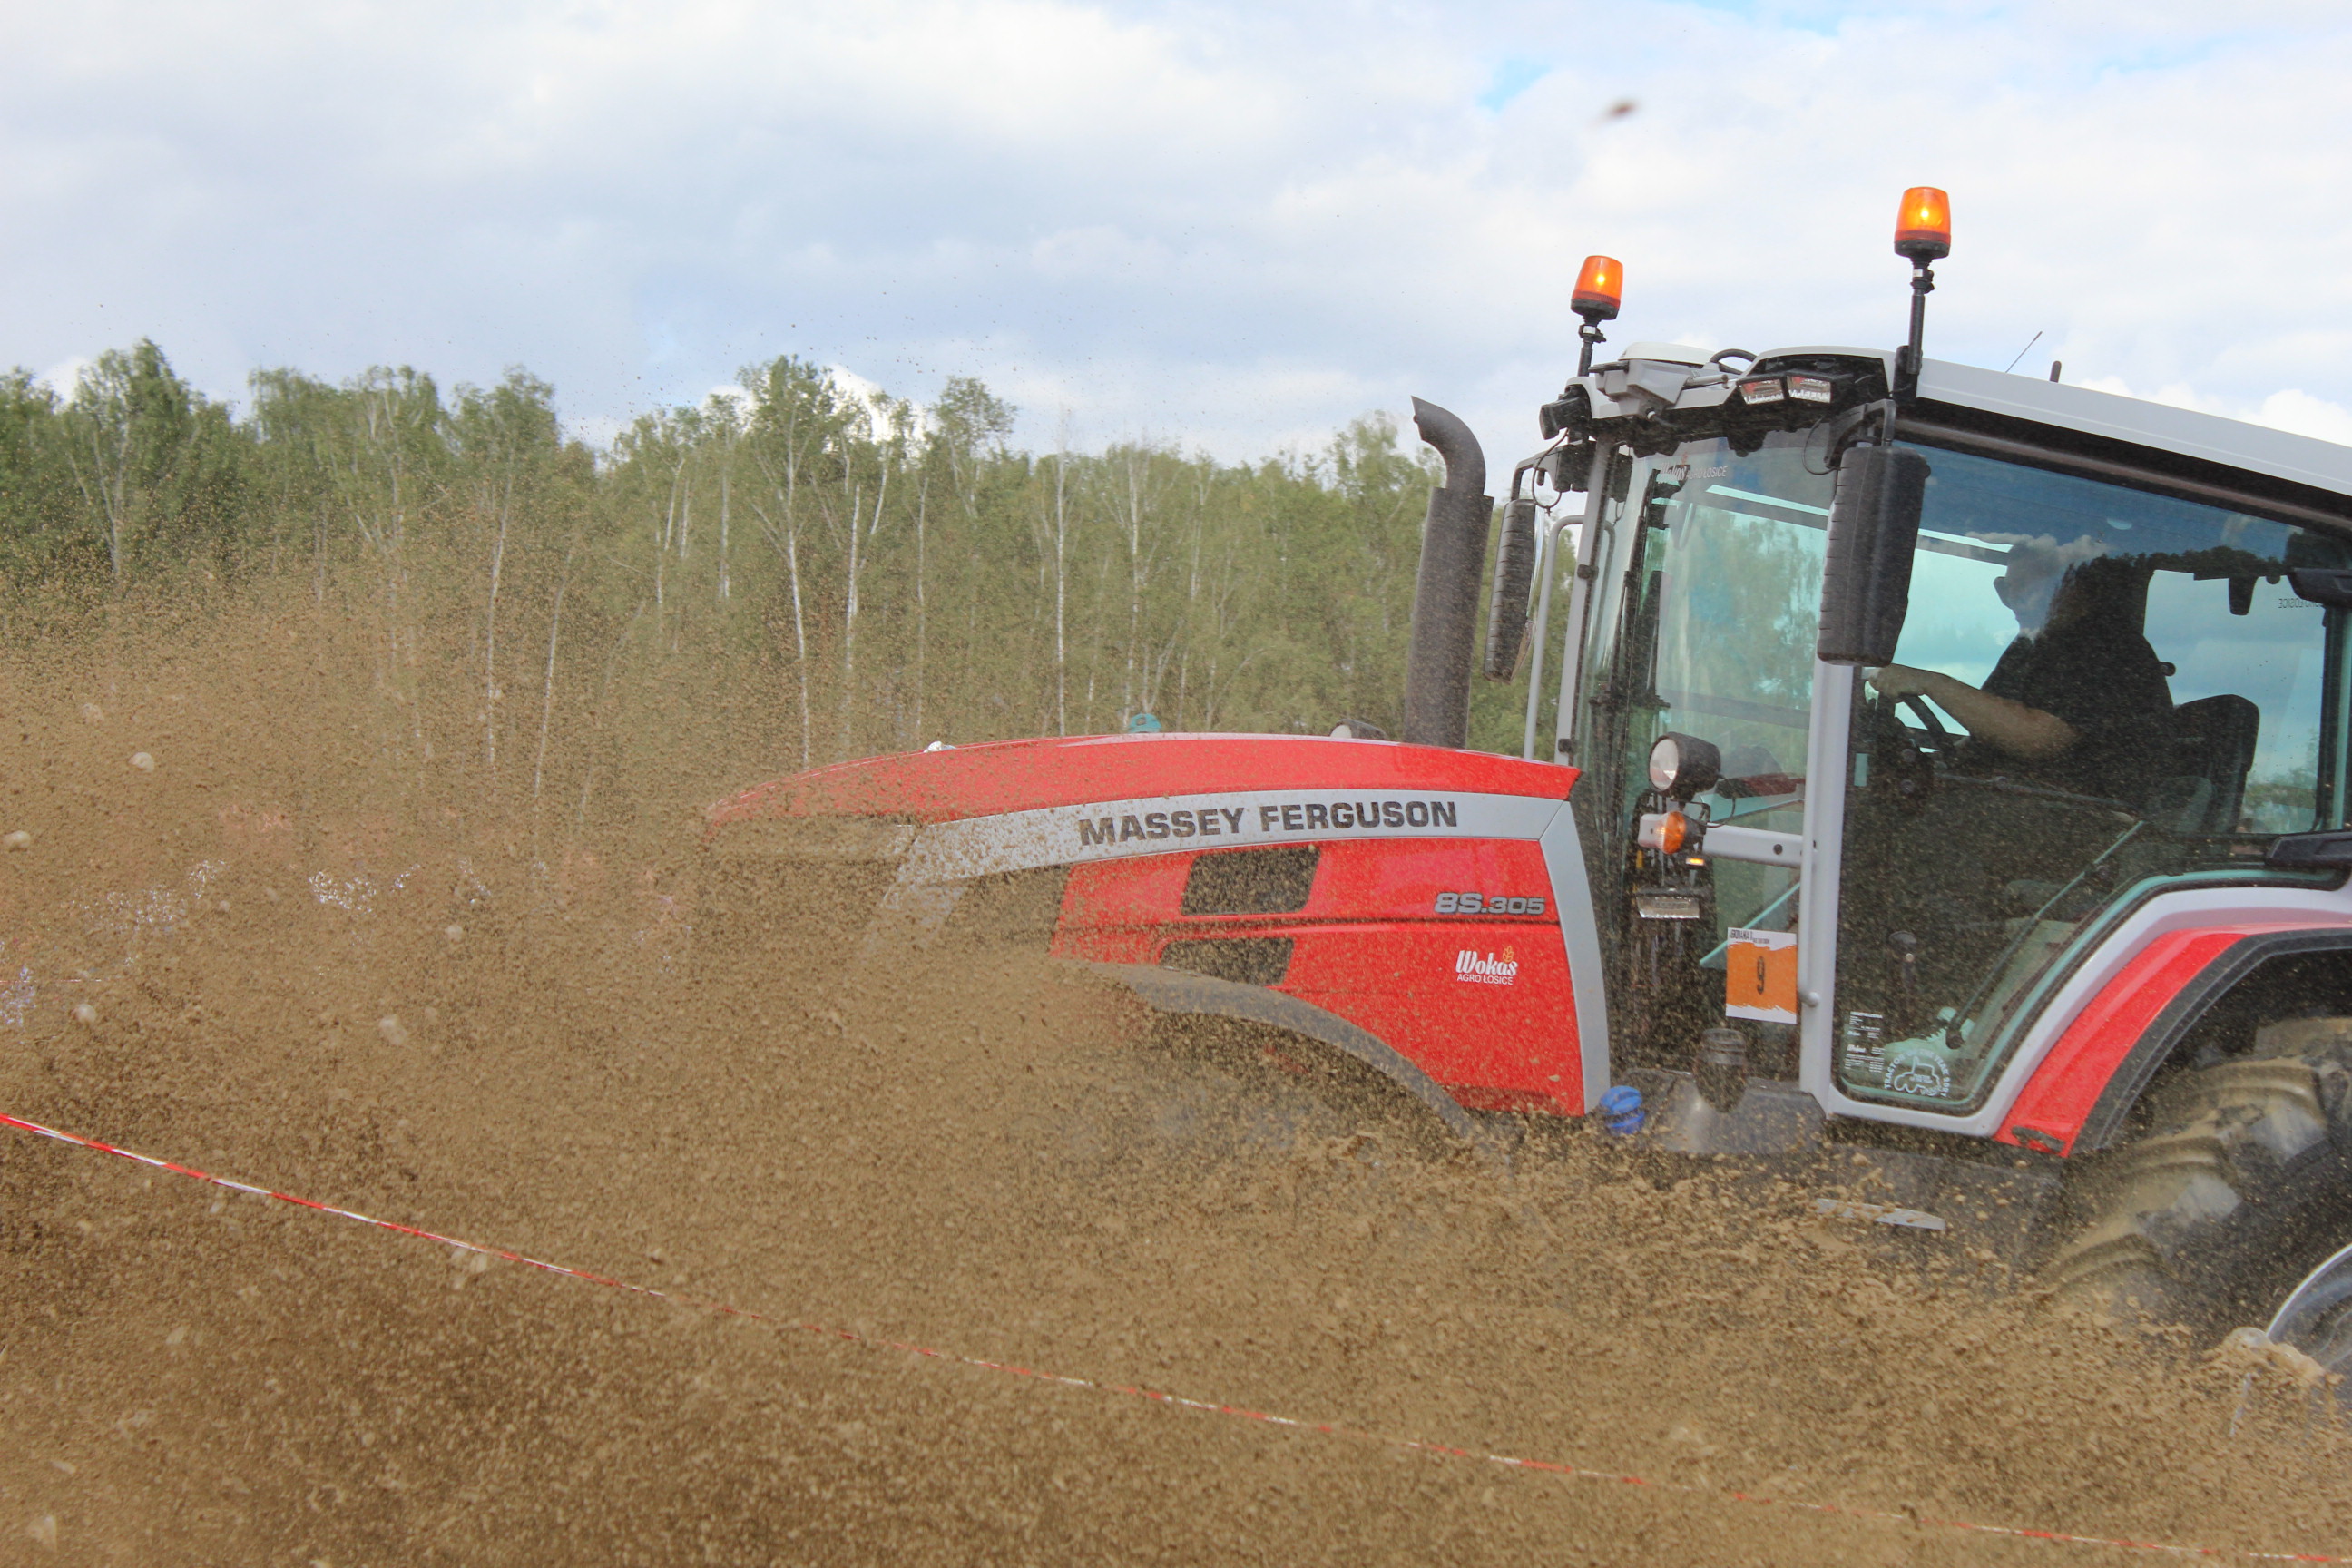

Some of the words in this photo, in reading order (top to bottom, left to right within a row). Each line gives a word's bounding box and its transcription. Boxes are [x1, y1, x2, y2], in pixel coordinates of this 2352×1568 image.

[1079, 807, 1245, 846] MASSEY
[1259, 800, 1458, 832] FERGUSON
[1435, 892, 1545, 915] 8S.305
[1455, 950, 1518, 976] Wokas
[1756, 956, 1766, 995] 9
[1457, 974, 1482, 983] AGRO
[1483, 975, 1514, 985] ŁOSICE
[1884, 1053, 1906, 1089] TRACTOR
[1934, 1054, 1950, 1076] YEAR
